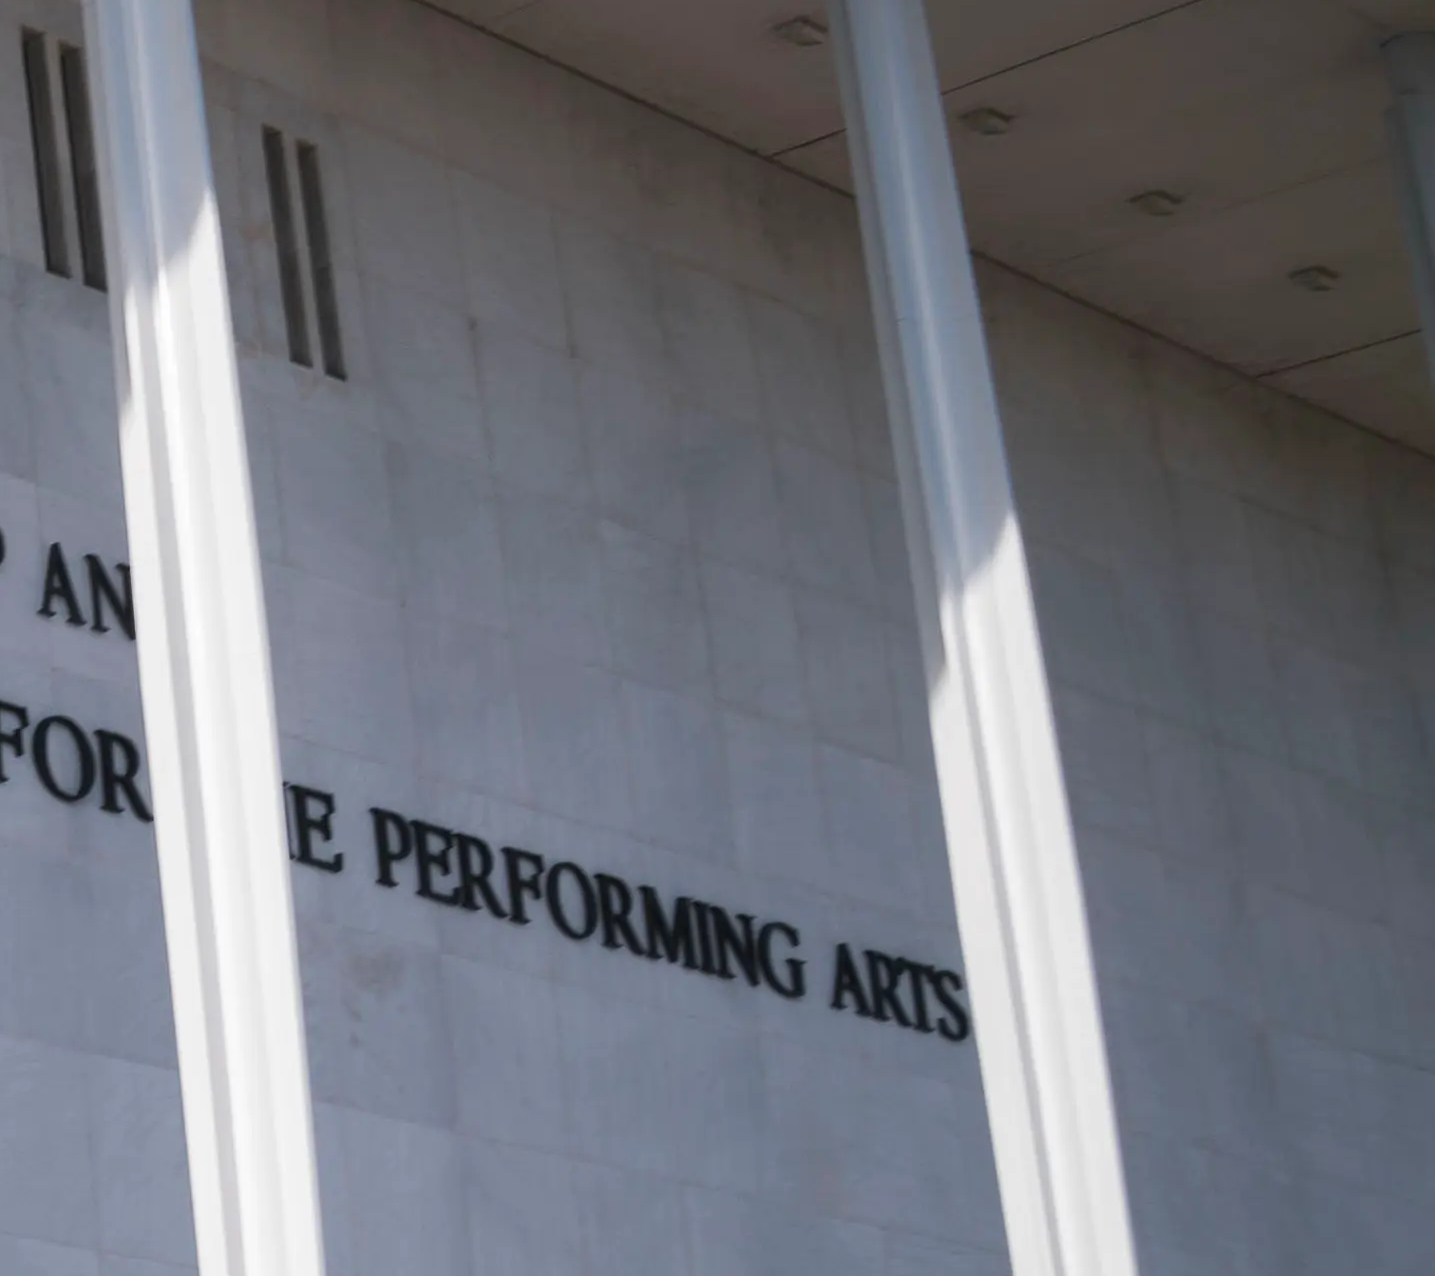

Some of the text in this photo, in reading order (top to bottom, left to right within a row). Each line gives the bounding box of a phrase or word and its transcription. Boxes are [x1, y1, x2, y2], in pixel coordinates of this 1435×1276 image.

[36, 541, 136, 642] AN
[368, 806, 807, 1001] PERFORMING
[829, 941, 971, 1044] ARTS
